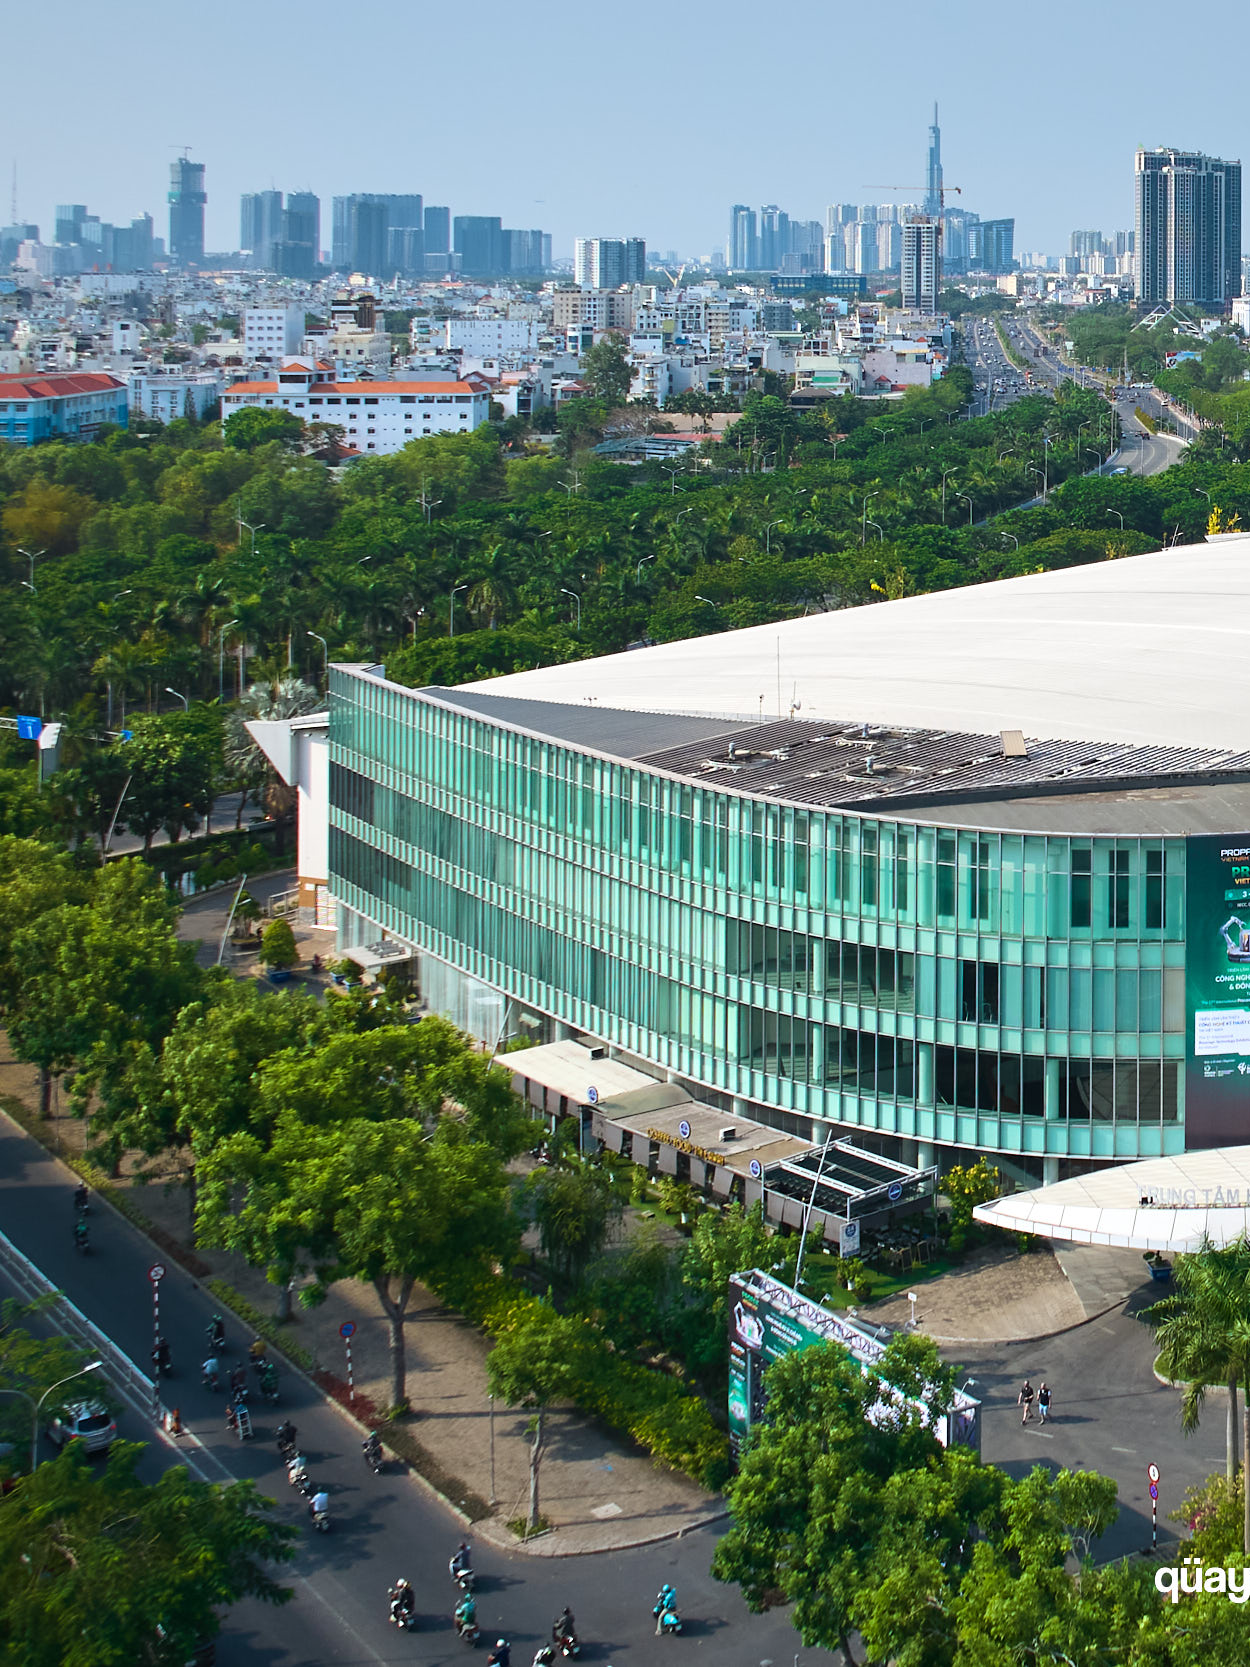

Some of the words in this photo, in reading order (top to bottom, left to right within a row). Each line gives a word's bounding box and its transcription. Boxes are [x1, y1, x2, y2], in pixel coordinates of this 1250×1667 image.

[1242, 890, 1247, 898] 3
[1215, 974, 1235, 983] CÔNG
[1203, 1185, 1239, 1204] TÂM
